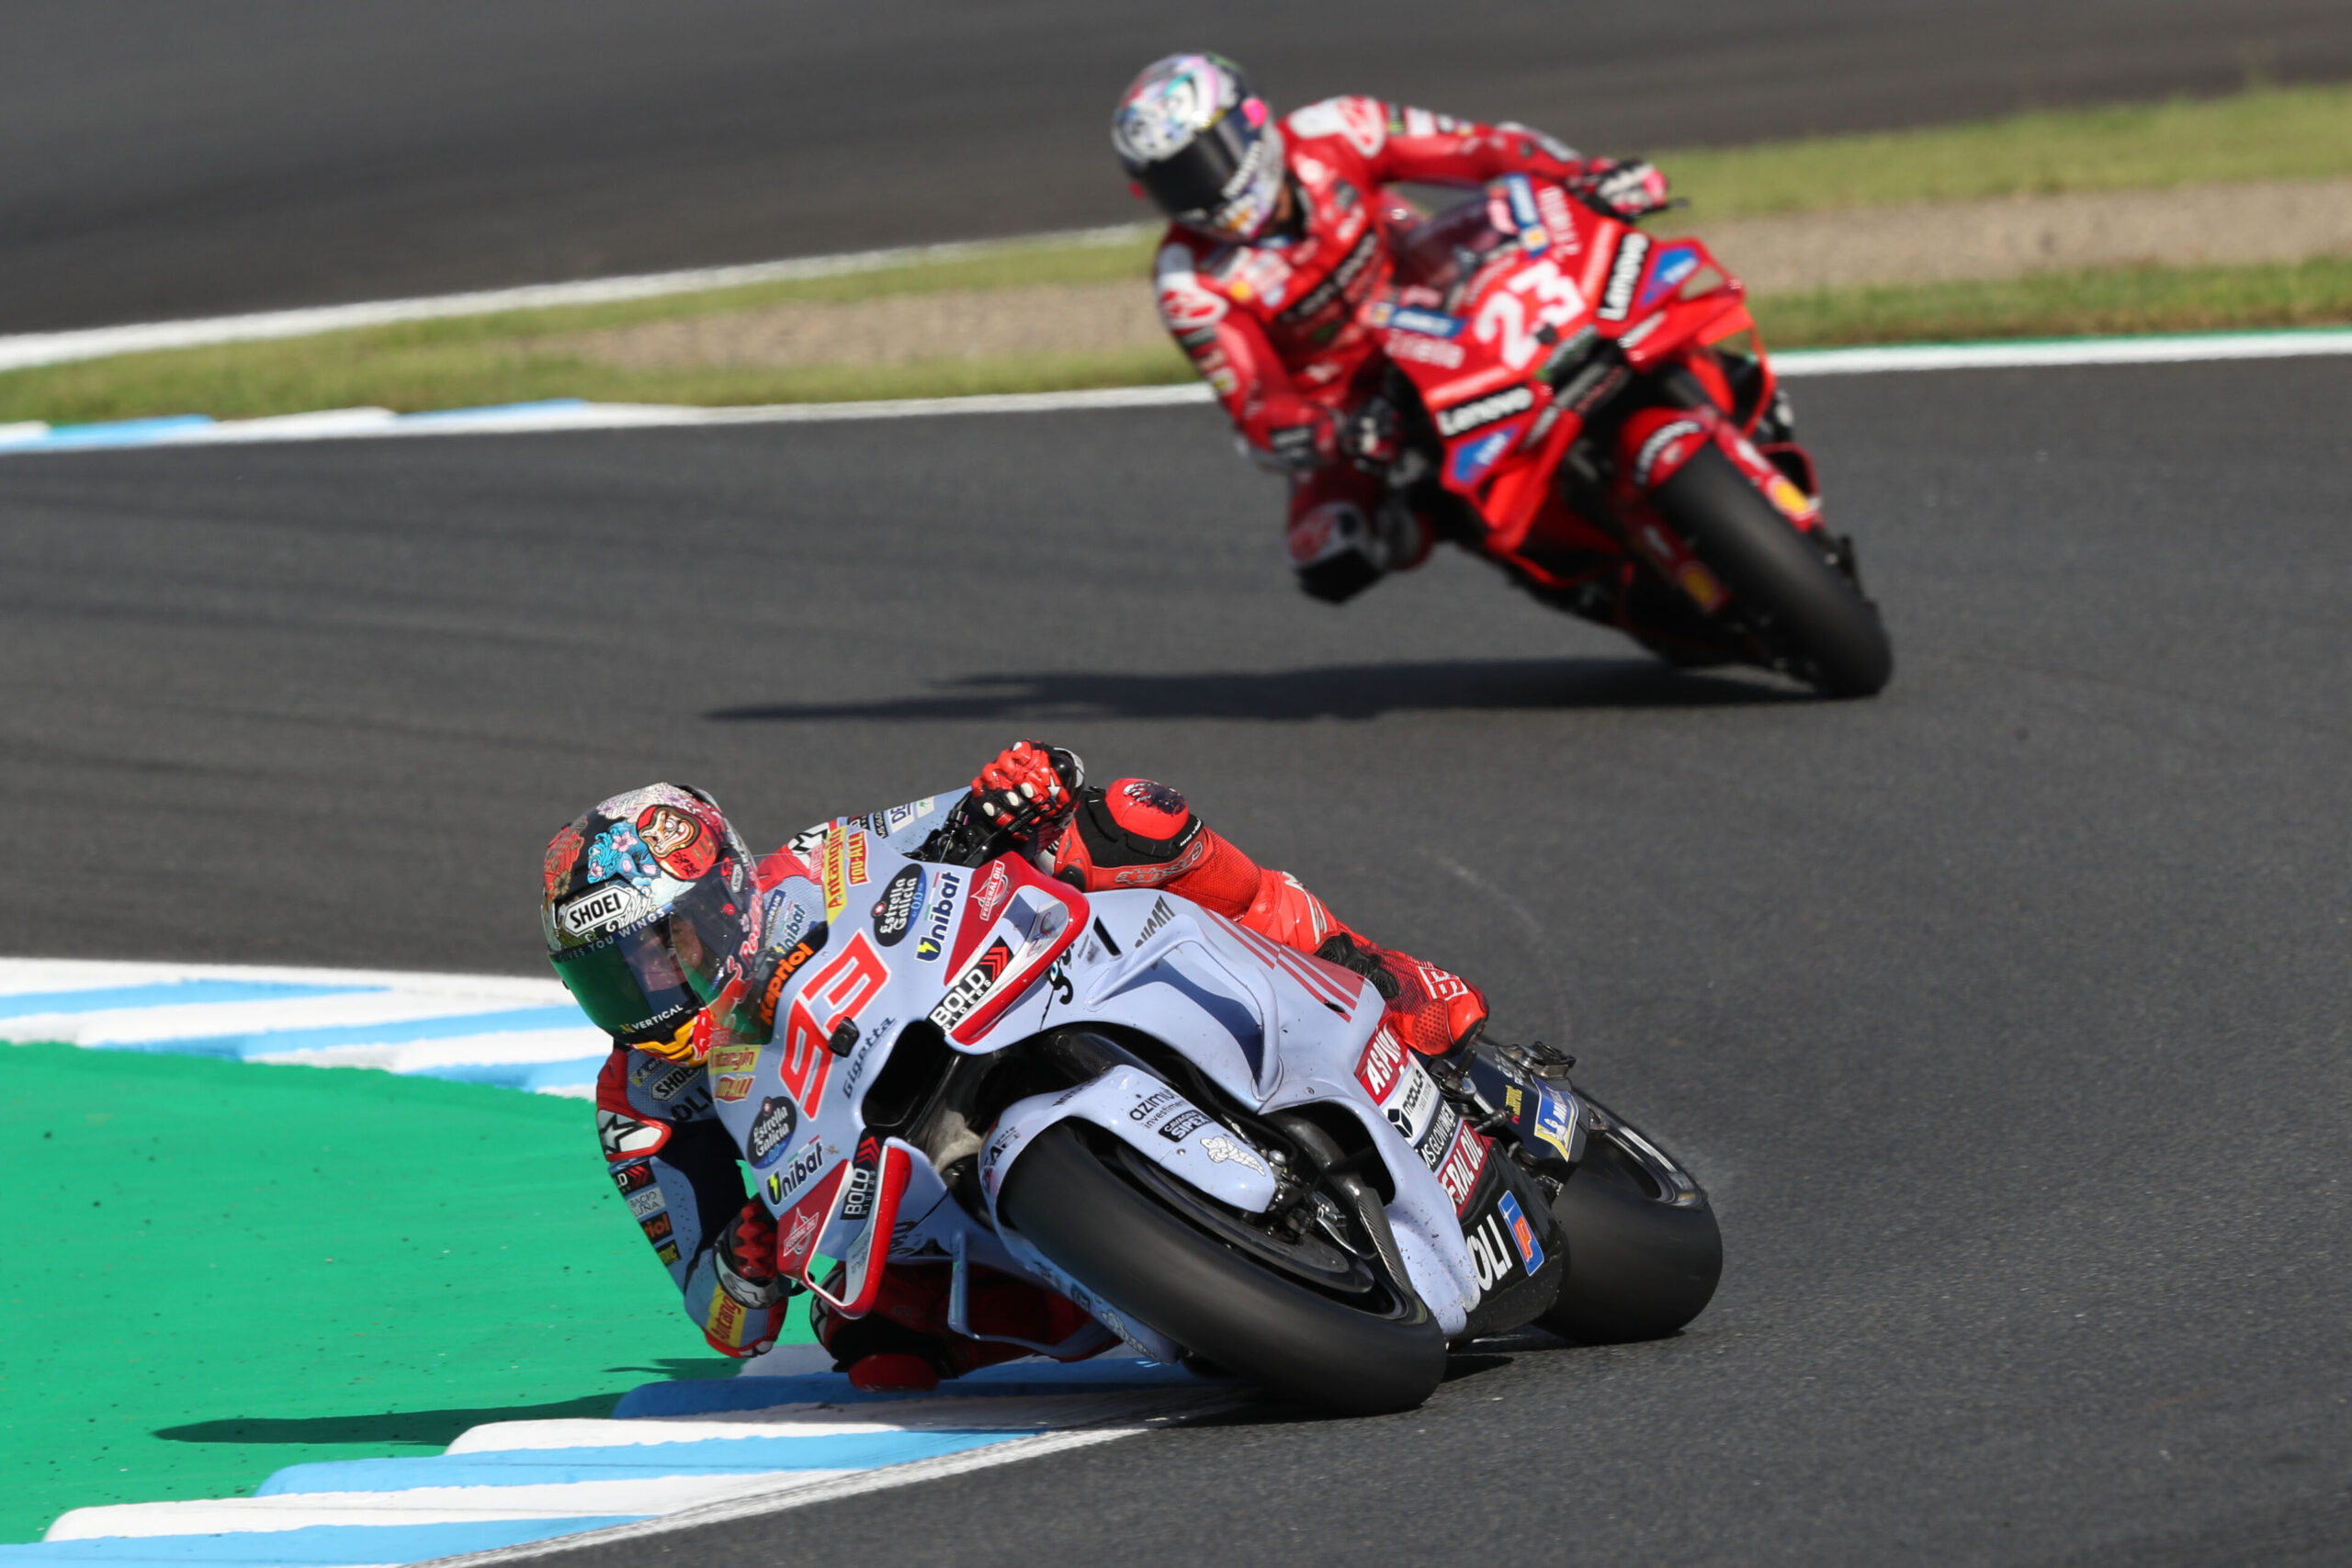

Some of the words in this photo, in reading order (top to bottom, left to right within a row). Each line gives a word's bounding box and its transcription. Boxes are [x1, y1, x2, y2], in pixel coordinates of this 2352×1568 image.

[1474, 260, 1587, 370] 23
[827, 825, 844, 909] Antangin
[982, 880, 997, 917] FEDERAL
[992, 866, 1001, 880] OIL
[570, 893, 622, 929] SHOEI
[879, 877, 907, 934] Estrella
[893, 877, 918, 930] Galicia
[916, 872, 960, 962] Unibat
[590, 936, 615, 952] YOU
[618, 908, 666, 938] WINGS
[631, 1004, 684, 1031] VERTICAL
[930, 968, 986, 1027] BOLD
[943, 979, 992, 1033] RIDERS
[753, 1106, 788, 1145] Estrella
[755, 1122, 791, 1157] Galicia
[1171, 1114, 1208, 1139] SIPEX
[1461, 1126, 1484, 1171] OIL
[765, 1142, 825, 1206] Unibat
[844, 1168, 870, 1215] BOLD
